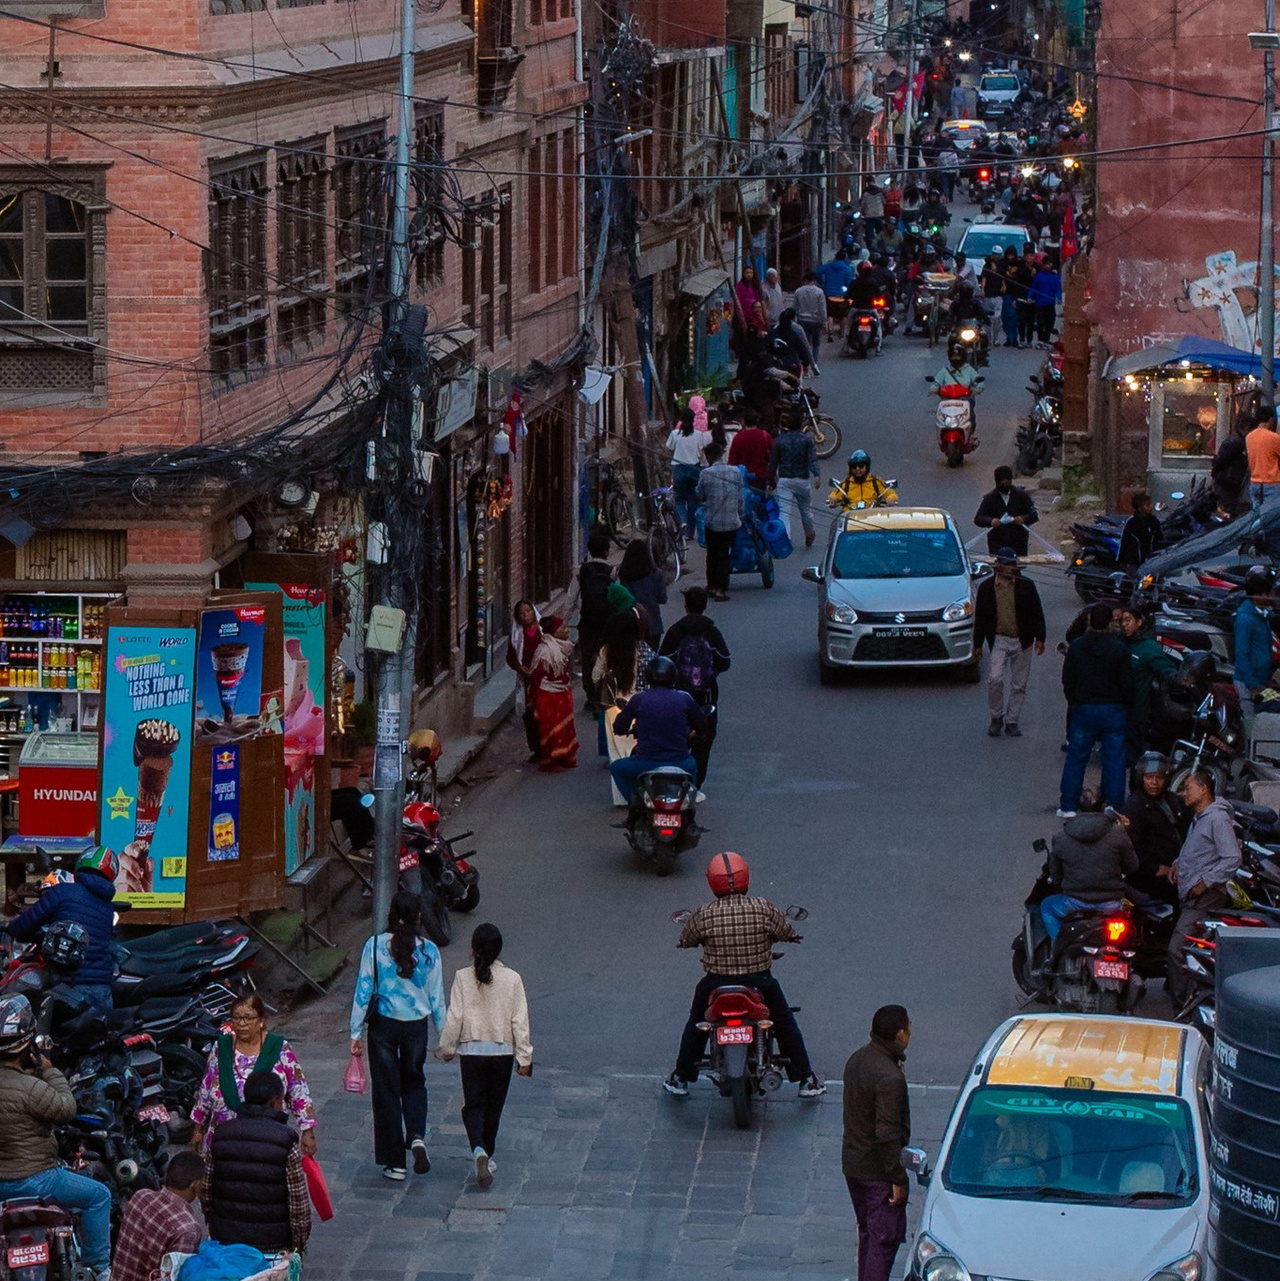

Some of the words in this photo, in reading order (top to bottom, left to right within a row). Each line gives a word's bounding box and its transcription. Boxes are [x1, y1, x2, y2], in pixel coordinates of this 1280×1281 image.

[126, 662, 166, 681] NOTHING
[129, 679, 150, 697] LESS
[153, 675, 176, 693] THAN
[178, 674, 185, 689] A
[133, 692, 165, 712] WORLD
[166, 688, 190, 706] CONE
[1007, 1097, 1059, 1107] CITY
